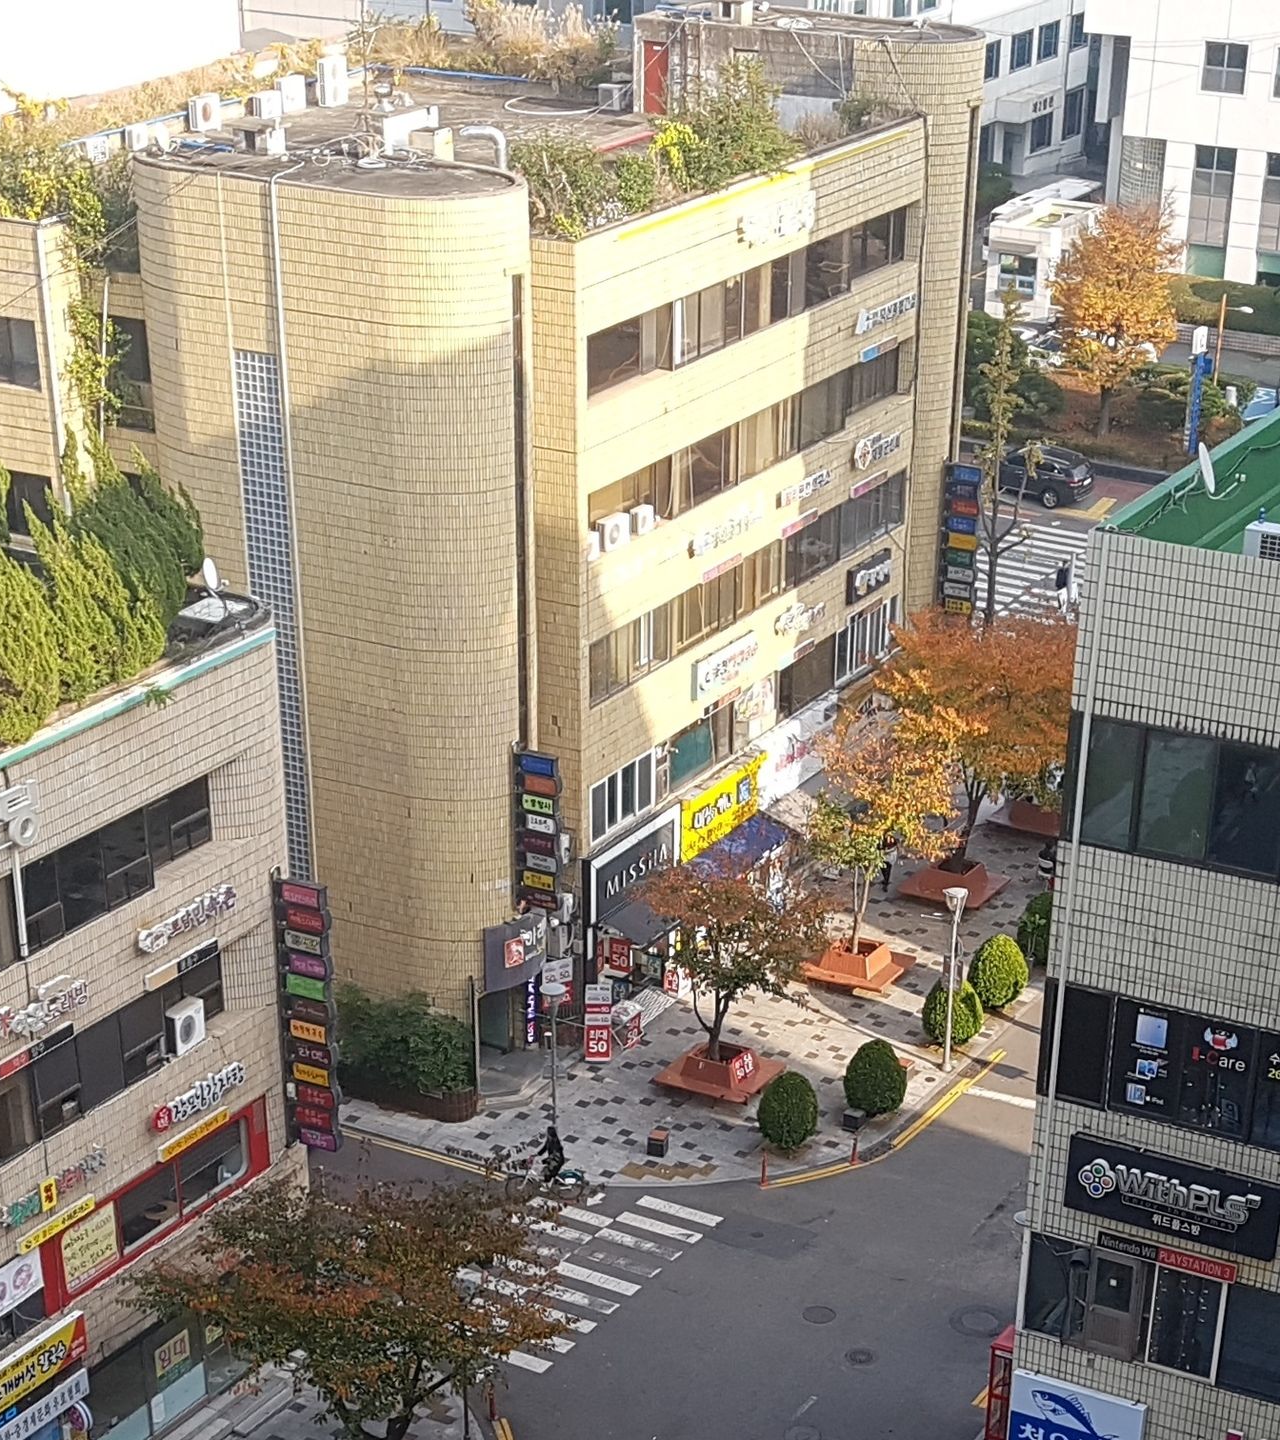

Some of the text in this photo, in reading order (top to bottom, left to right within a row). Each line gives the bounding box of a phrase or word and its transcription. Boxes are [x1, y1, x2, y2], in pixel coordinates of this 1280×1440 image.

[588, 1040, 608, 1053] 50
[1100, 1234, 1141, 1256] Nintendo
[1158, 1250, 1231, 1279] PLAYSTATION 3
